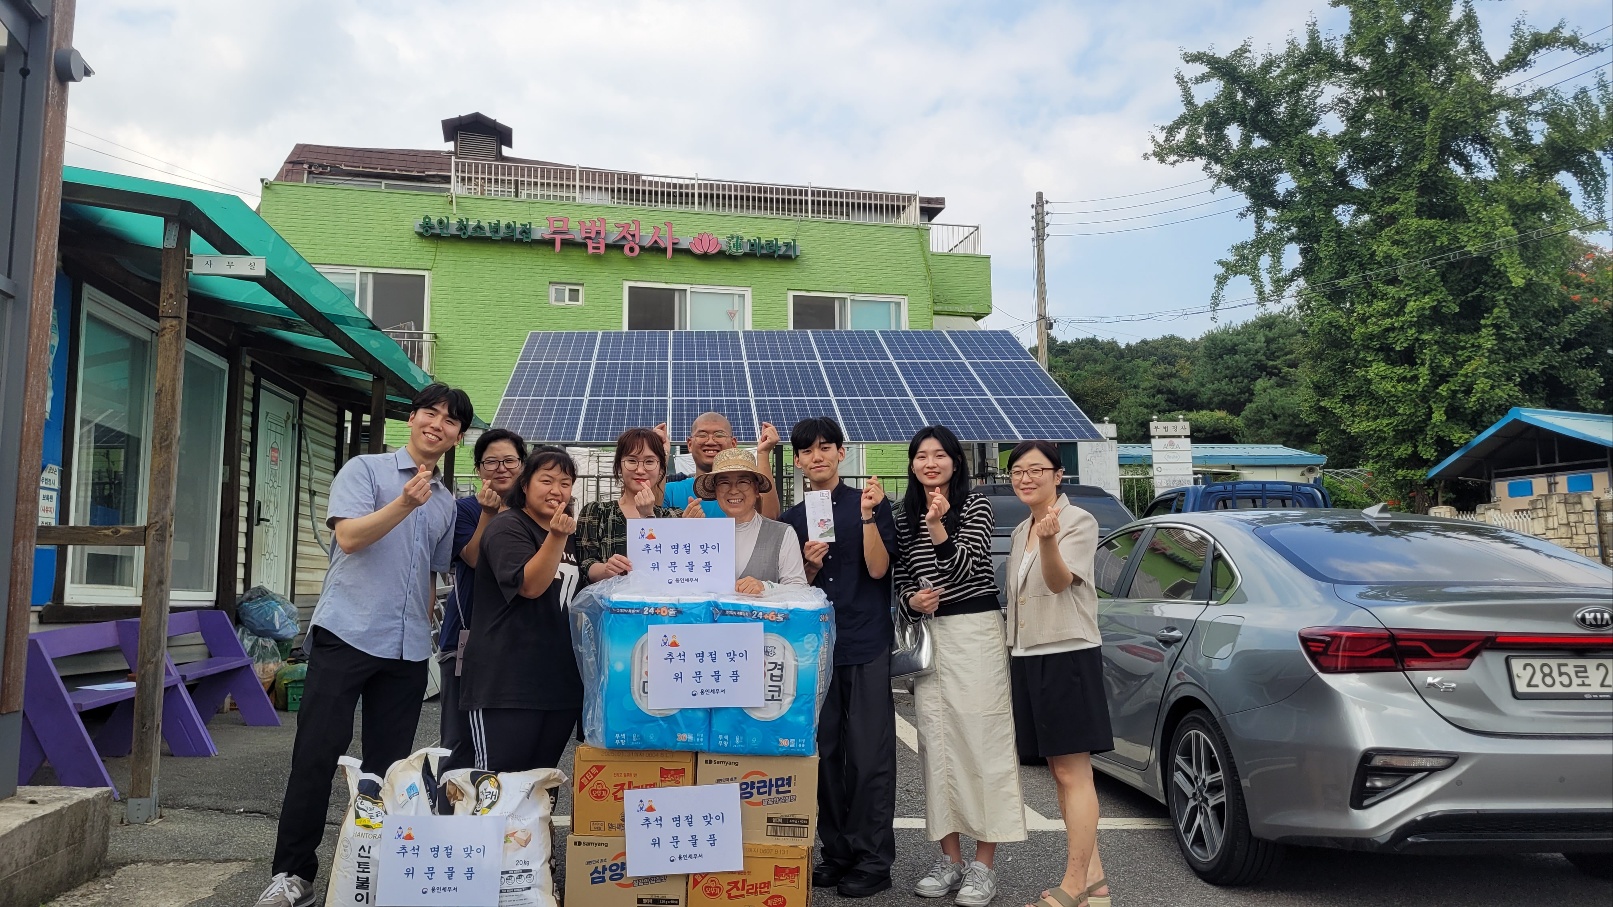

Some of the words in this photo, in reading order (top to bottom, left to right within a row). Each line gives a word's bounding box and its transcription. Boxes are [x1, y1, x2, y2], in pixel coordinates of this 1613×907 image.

[419, 215, 451, 237] 용인
[541, 216, 681, 259] 무법정사
[642, 543, 662, 554] 추석
[671, 543, 691, 554] 명절
[700, 542, 720, 554] 맞이
[664, 651, 686, 664] 추석
[695, 651, 717, 663] 명절
[726, 650, 748, 662] 맞이
[1522, 662, 1592, 688] 285로
[740, 776, 793, 800] 양라면
[641, 816, 663, 829] 추석
[672, 814, 693, 828] 명절
[702, 812, 725, 826] 맞이
[396, 845, 420, 858] 추석
[430, 844, 453, 858] 명절
[463, 845, 486, 859] 맞이
[355, 844, 371, 904] 신토불이
[590, 862, 626, 885] 삼양
[704, 886, 721, 895] 오뚜기
[725, 879, 772, 900] 진라면
